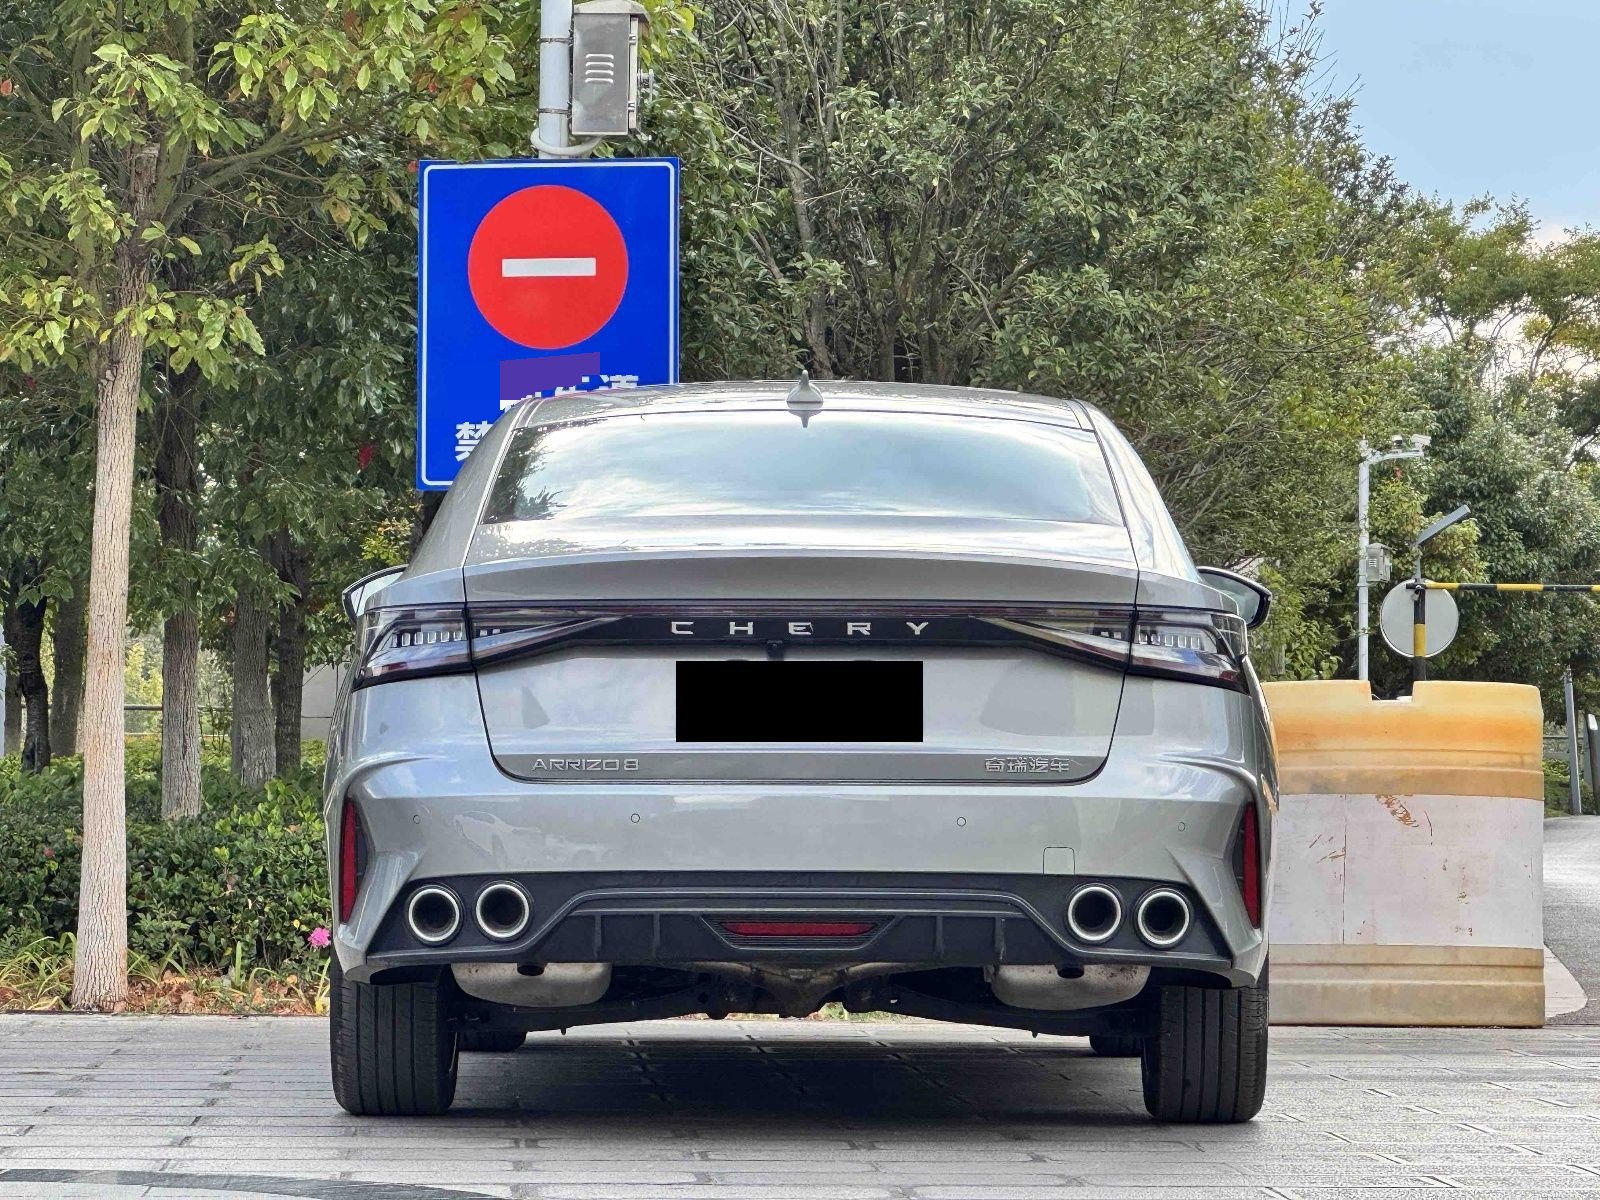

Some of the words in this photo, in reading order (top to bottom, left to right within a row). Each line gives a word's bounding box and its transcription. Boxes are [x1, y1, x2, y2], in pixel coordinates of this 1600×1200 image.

[670, 621, 929, 635] CHERY
[984, 756, 1070, 773] 奇瑞汽车
